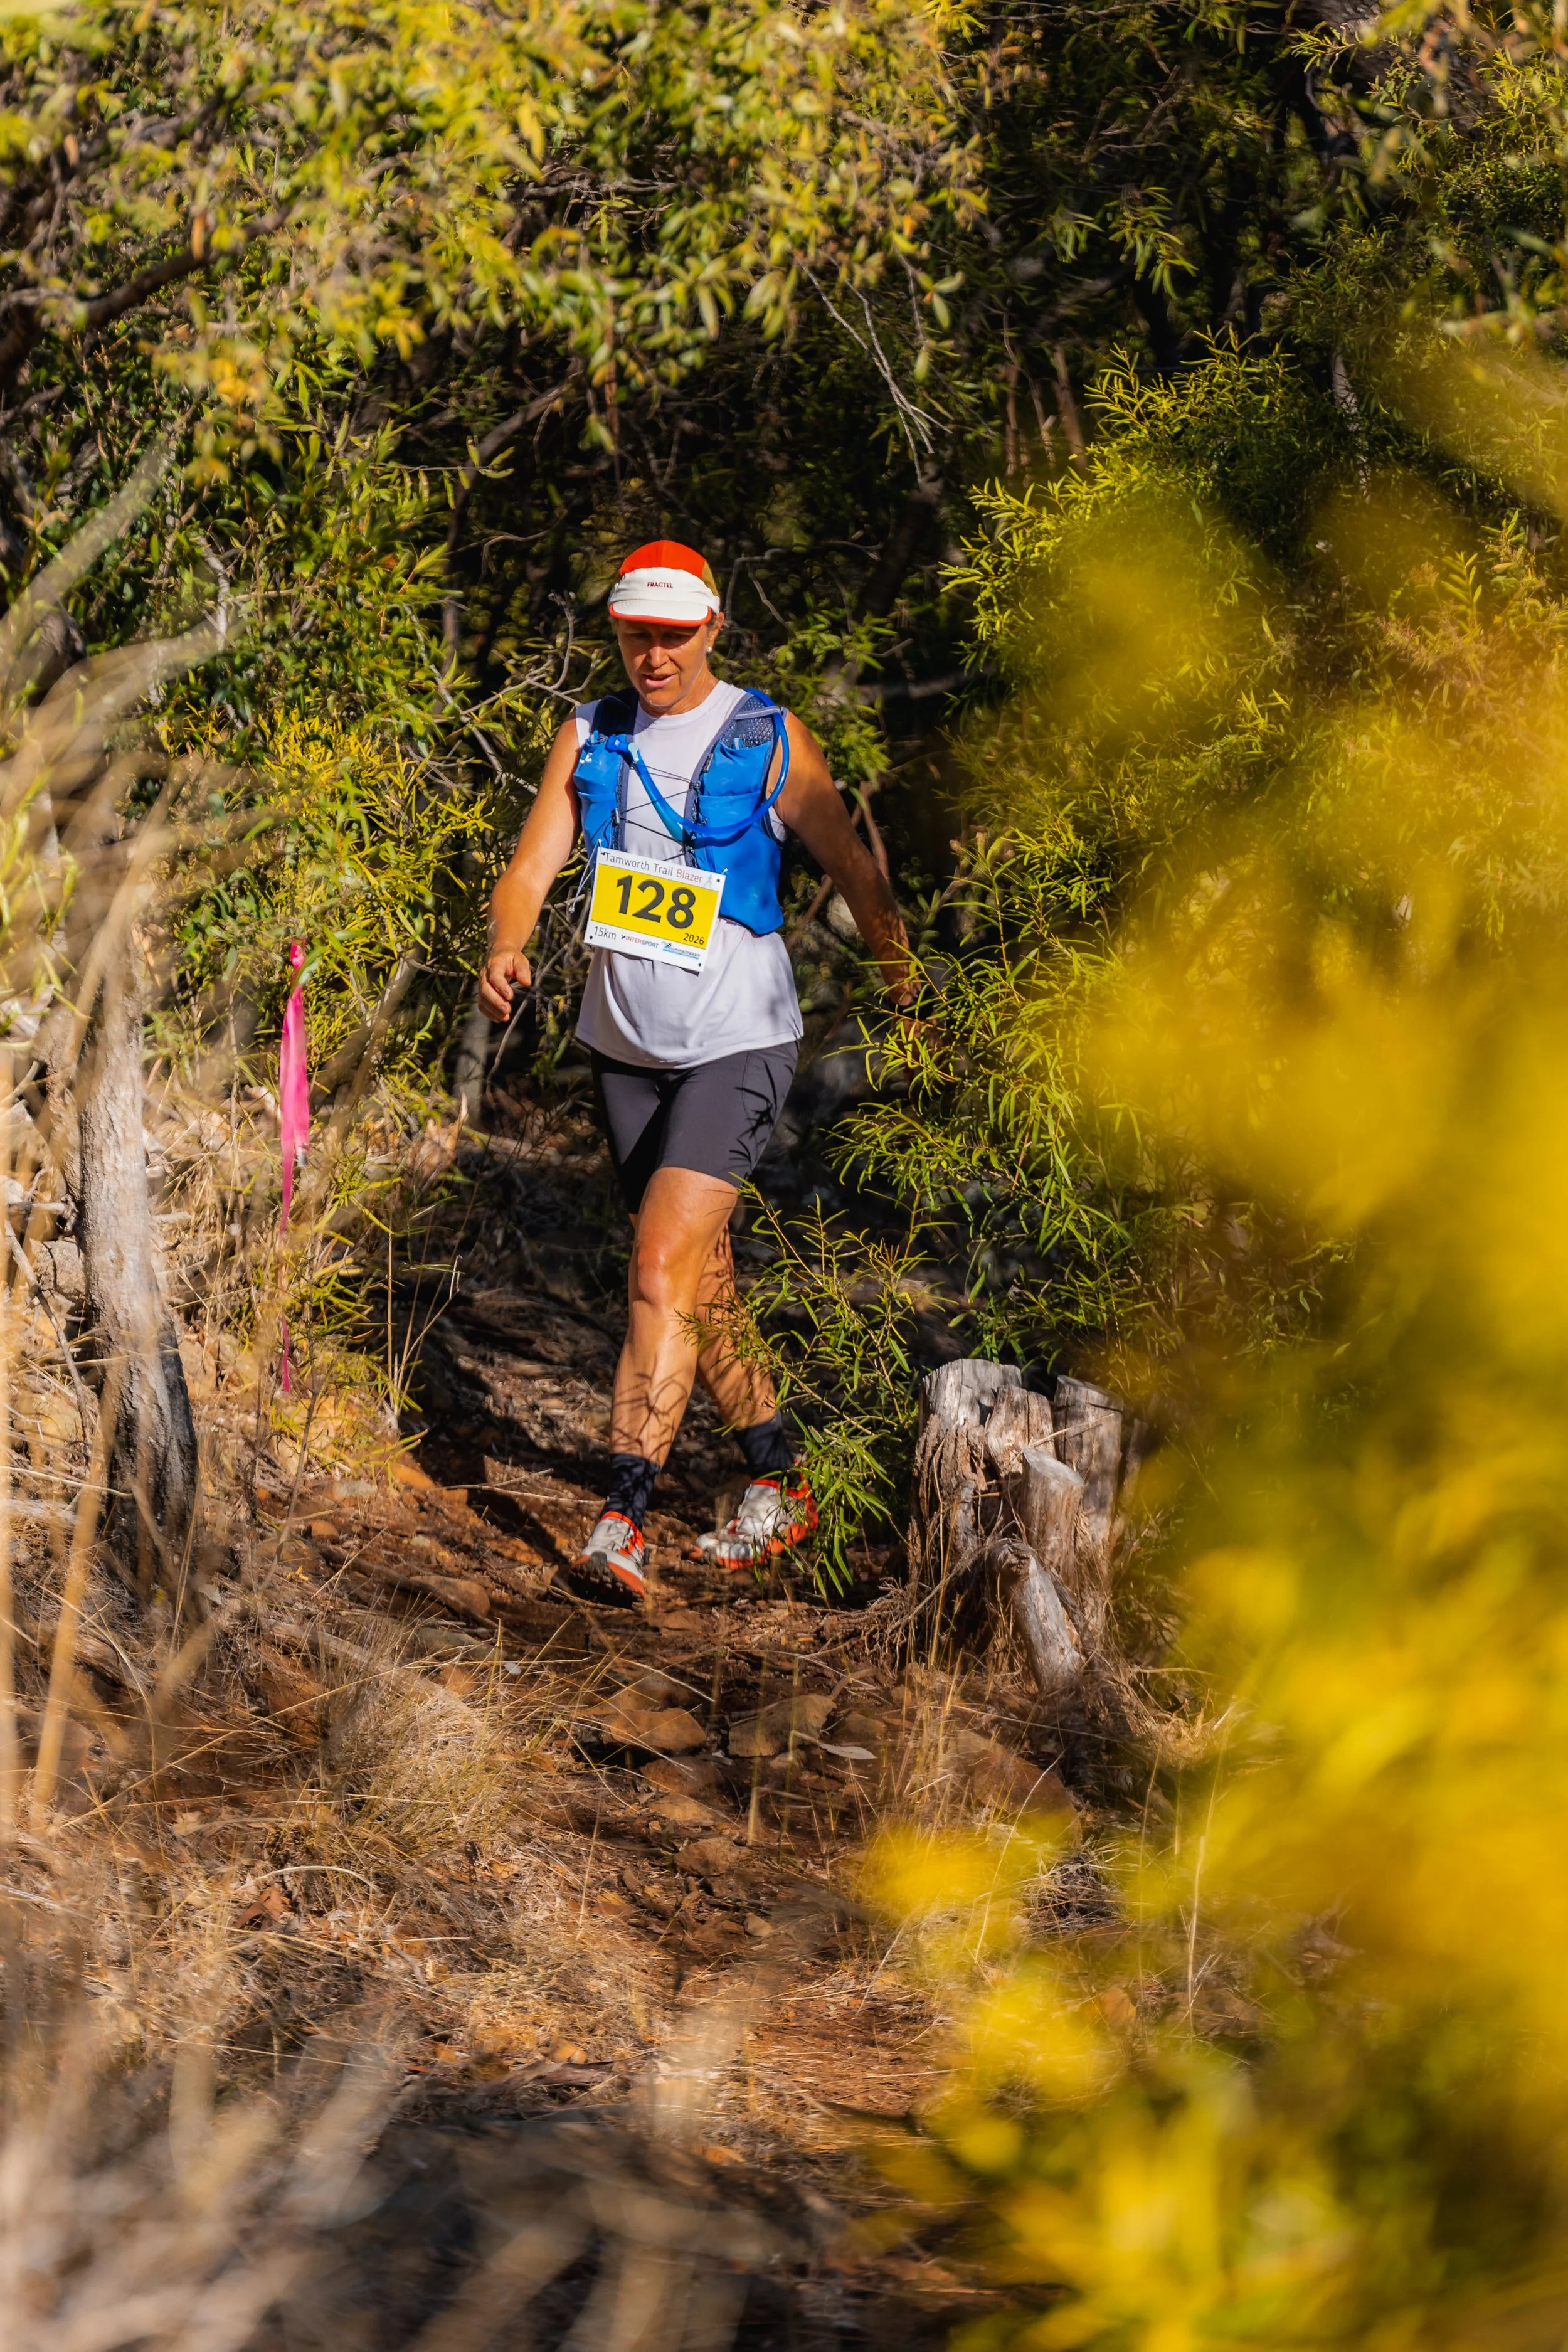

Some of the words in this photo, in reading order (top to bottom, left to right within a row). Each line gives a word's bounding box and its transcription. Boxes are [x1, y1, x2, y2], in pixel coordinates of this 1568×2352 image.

[605, 852, 650, 871] Tamworth
[654, 862, 673, 876] Trail
[676, 869, 703, 884] Blazer
[616, 874, 696, 930] 128
[594, 926, 617, 941] 15km
[683, 933, 704, 945] 2026
[626, 936, 659, 948] INTERSPORT
